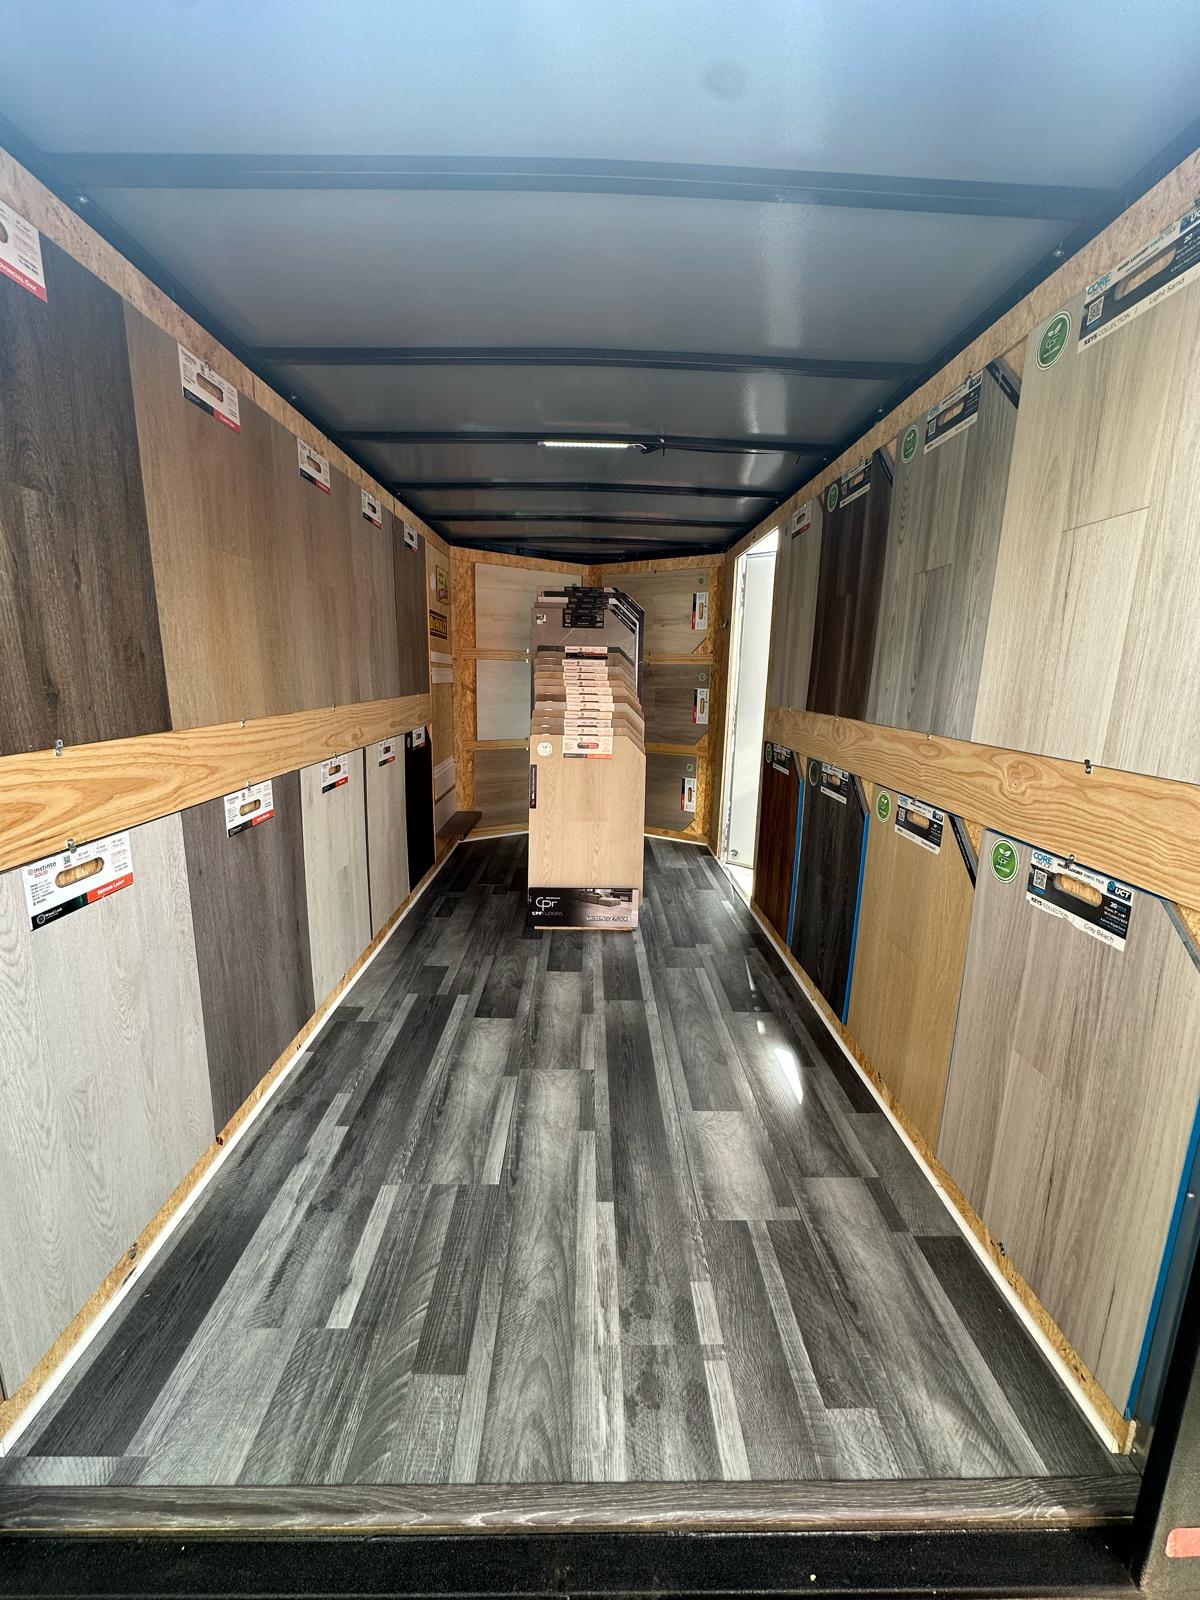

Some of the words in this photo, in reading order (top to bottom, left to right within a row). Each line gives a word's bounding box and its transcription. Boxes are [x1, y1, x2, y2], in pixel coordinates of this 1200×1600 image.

[1149, 291, 1166, 305] Light
[1167, 277, 1185, 293] Sand
[1033, 851, 1053, 865] CORE
[35, 869, 48, 878] SOLID
[1114, 886, 1130, 898] UCT
[1031, 897, 1043, 906] KEYS
[1042, 902, 1069, 919] COLLECTION
[1110, 901, 1118, 909] 20
[1096, 929, 1114, 943] Beach
